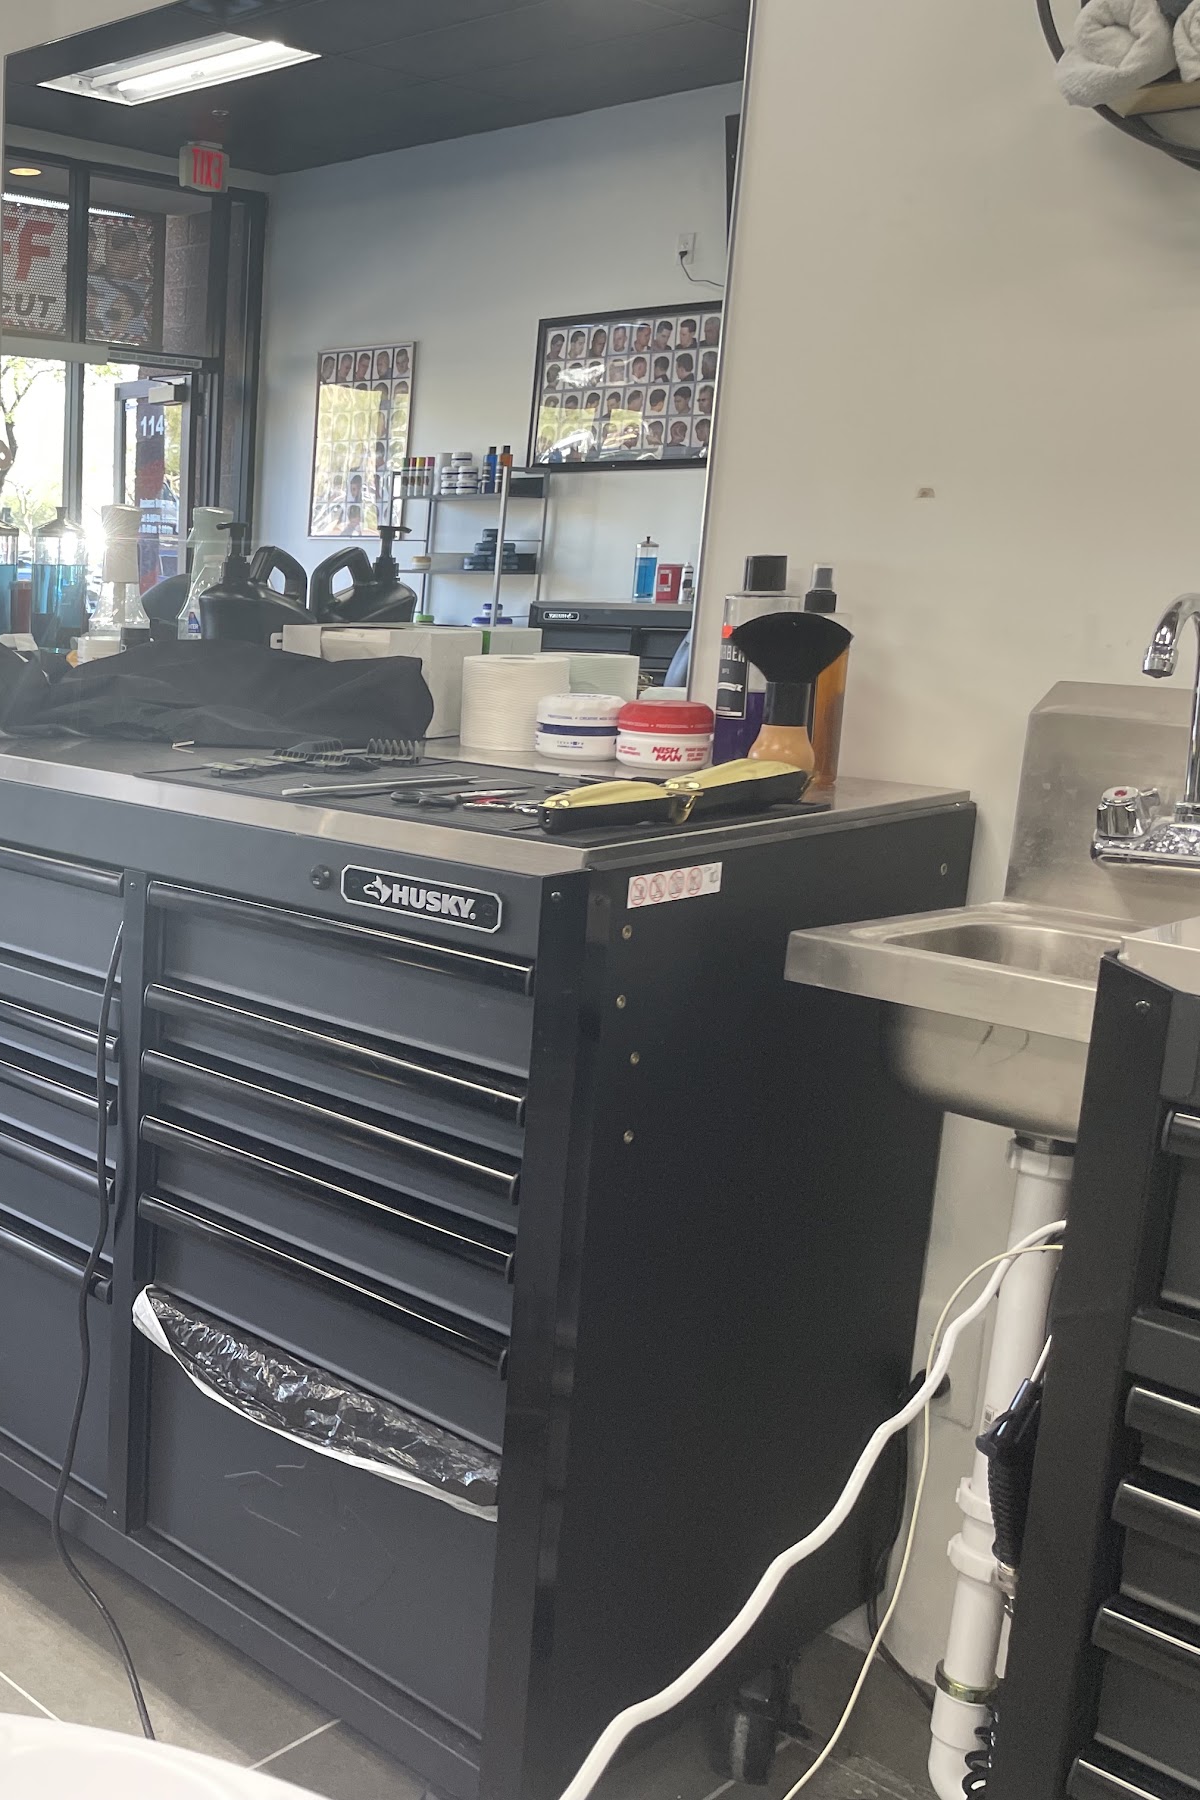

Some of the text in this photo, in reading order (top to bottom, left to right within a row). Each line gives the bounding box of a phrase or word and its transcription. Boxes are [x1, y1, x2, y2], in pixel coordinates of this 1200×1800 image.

[140, 414, 165, 437] 114
[651, 746, 680, 754] NISH
[655, 754, 682, 762] MAN
